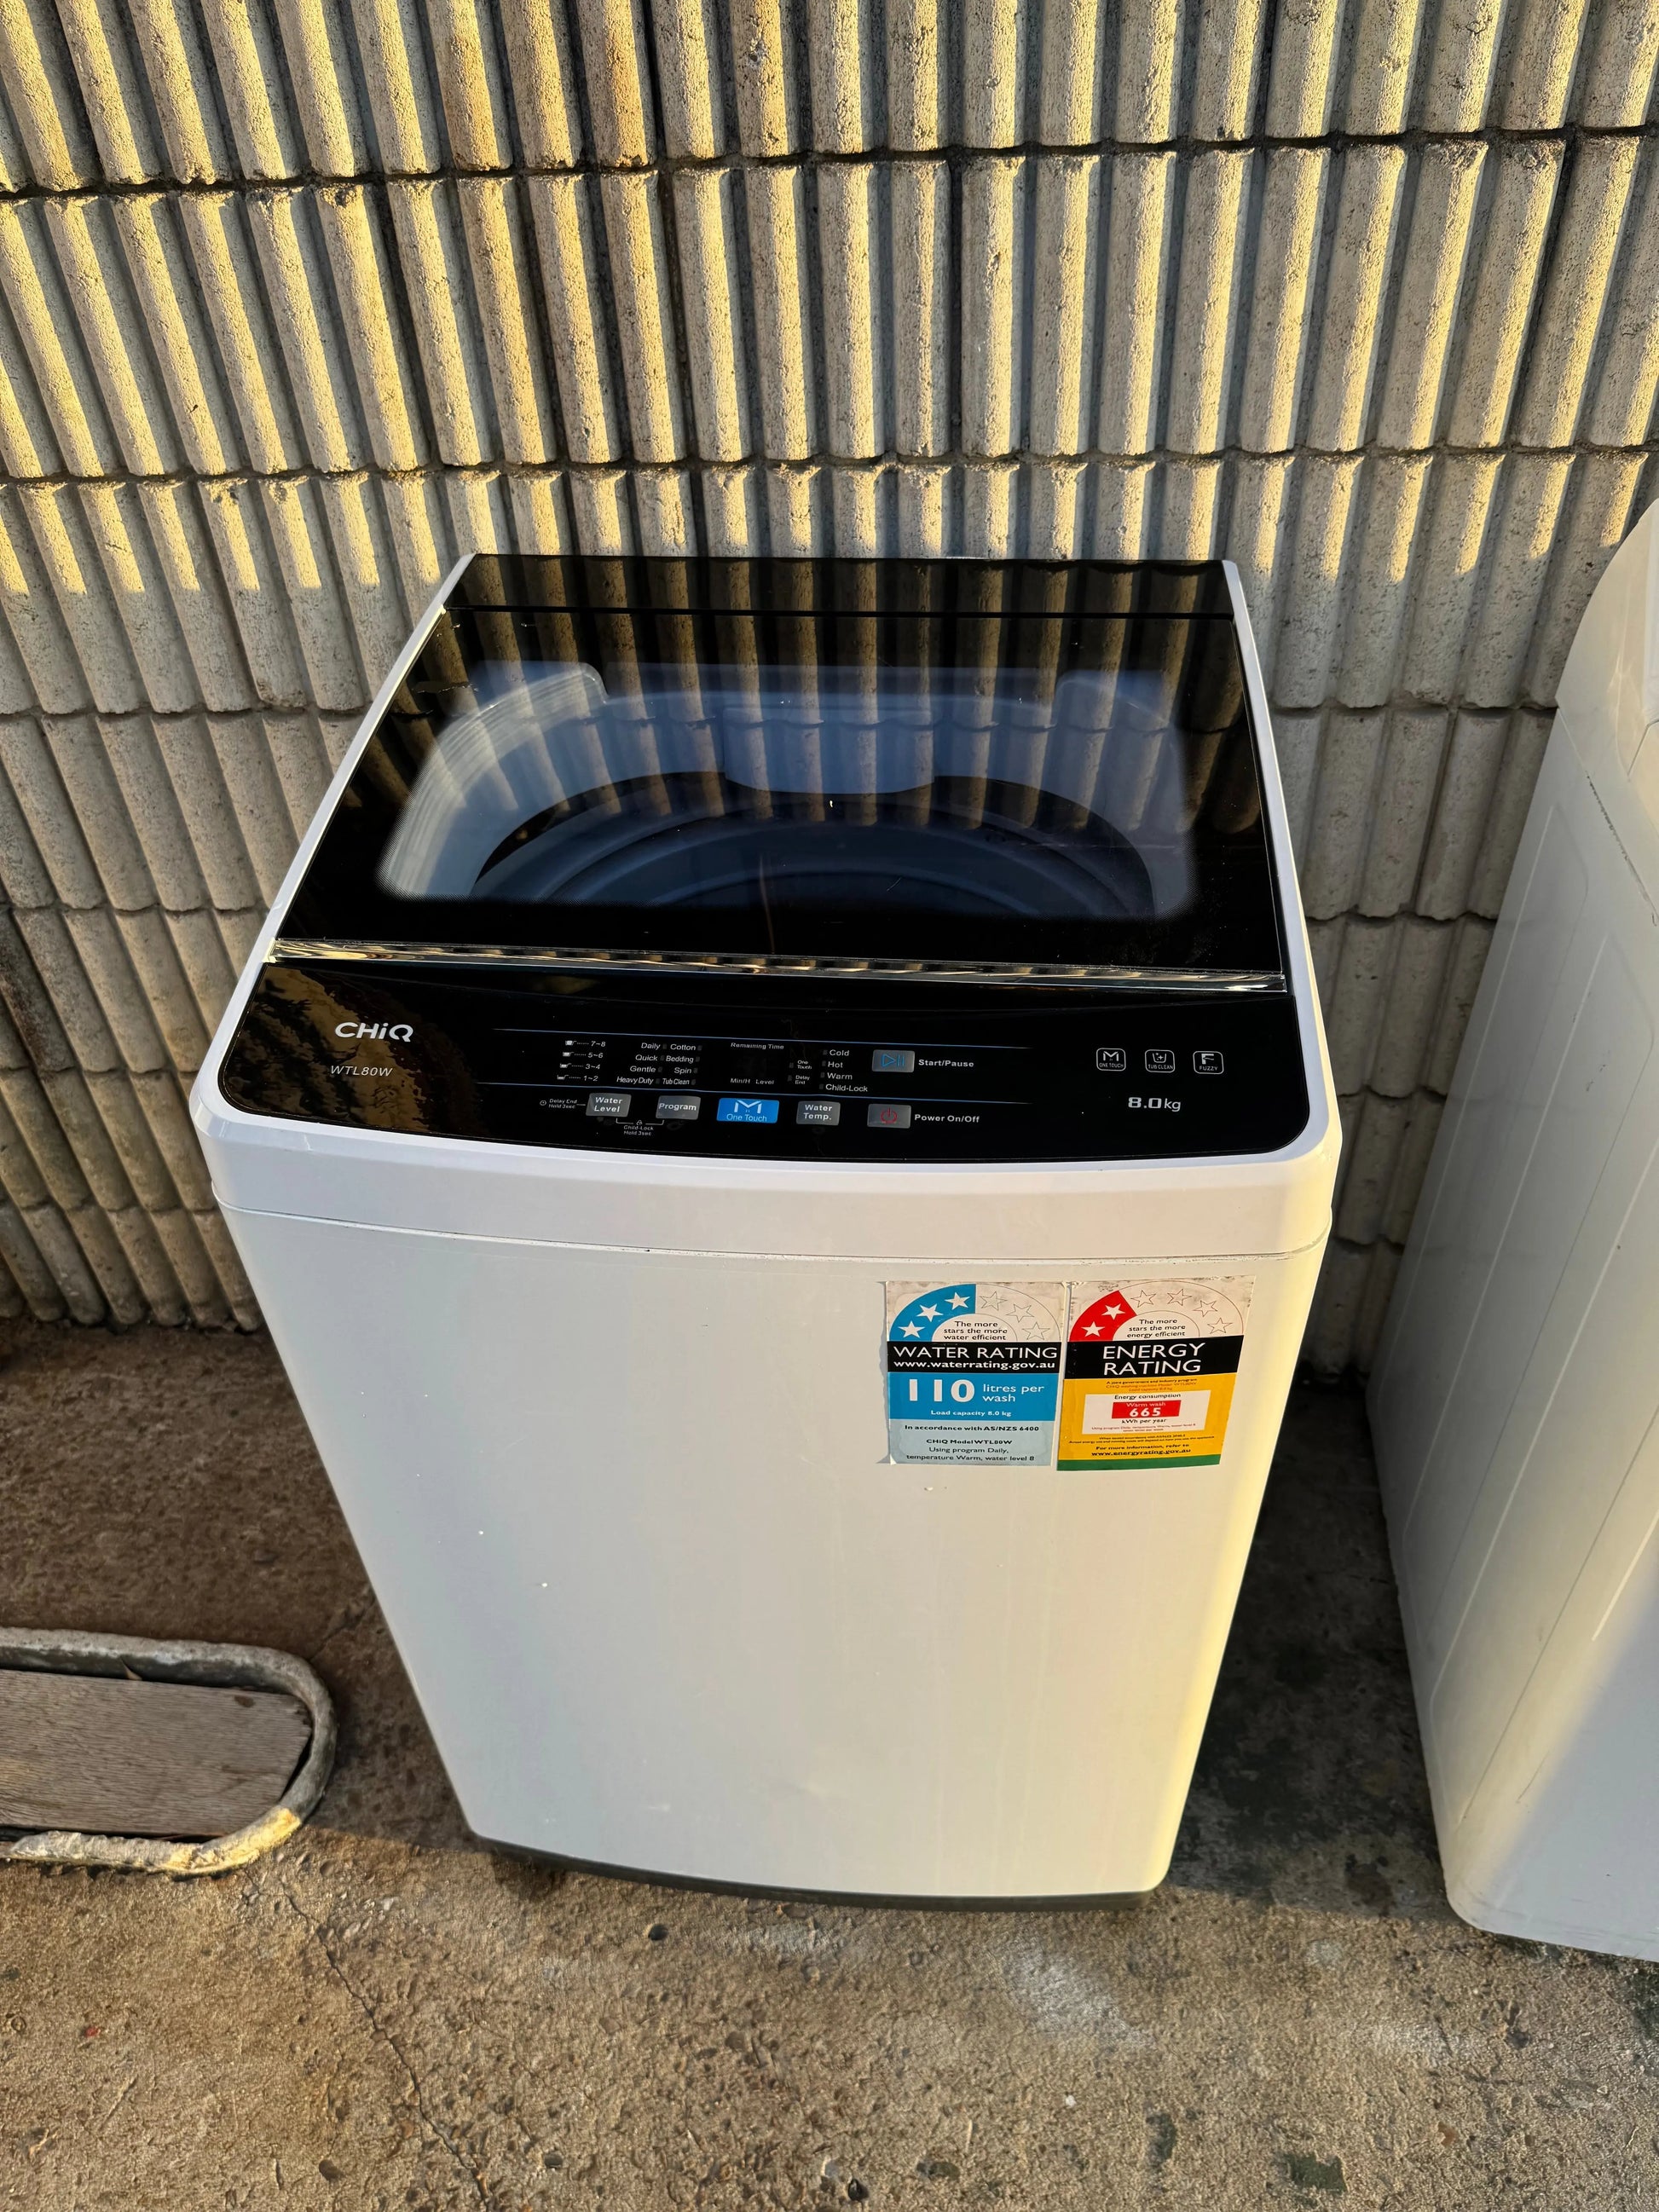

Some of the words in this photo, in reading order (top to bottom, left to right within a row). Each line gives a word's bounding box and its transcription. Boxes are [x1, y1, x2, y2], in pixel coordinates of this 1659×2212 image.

[335, 1022, 413, 1042] CHiQ
[666, 1055, 694, 1064] Bedding
[918, 1059, 974, 1067] Start/Pause
[331, 1066, 393, 1077] WTL80W
[827, 1071, 853, 1080] Warm
[616, 1076, 638, 1084] Heavy
[638, 1077, 654, 1085] Duty
[825, 1083, 868, 1092] Child-Lock
[658, 1103, 697, 1112] Program
[803, 1112, 832, 1121] Temp.
[893, 1346, 970, 1359] WATER
[977, 1347, 1057, 1359] RATING
[1103, 1343, 1205, 1359] ENERGY
[893, 1360, 1055, 1370] www.waterrating.gov.au
[1103, 1360, 1201, 1375] RATING
[909, 1379, 975, 1402] 110
[1021, 1386, 1044, 1395] per
[1130, 1407, 1161, 1417] 665
